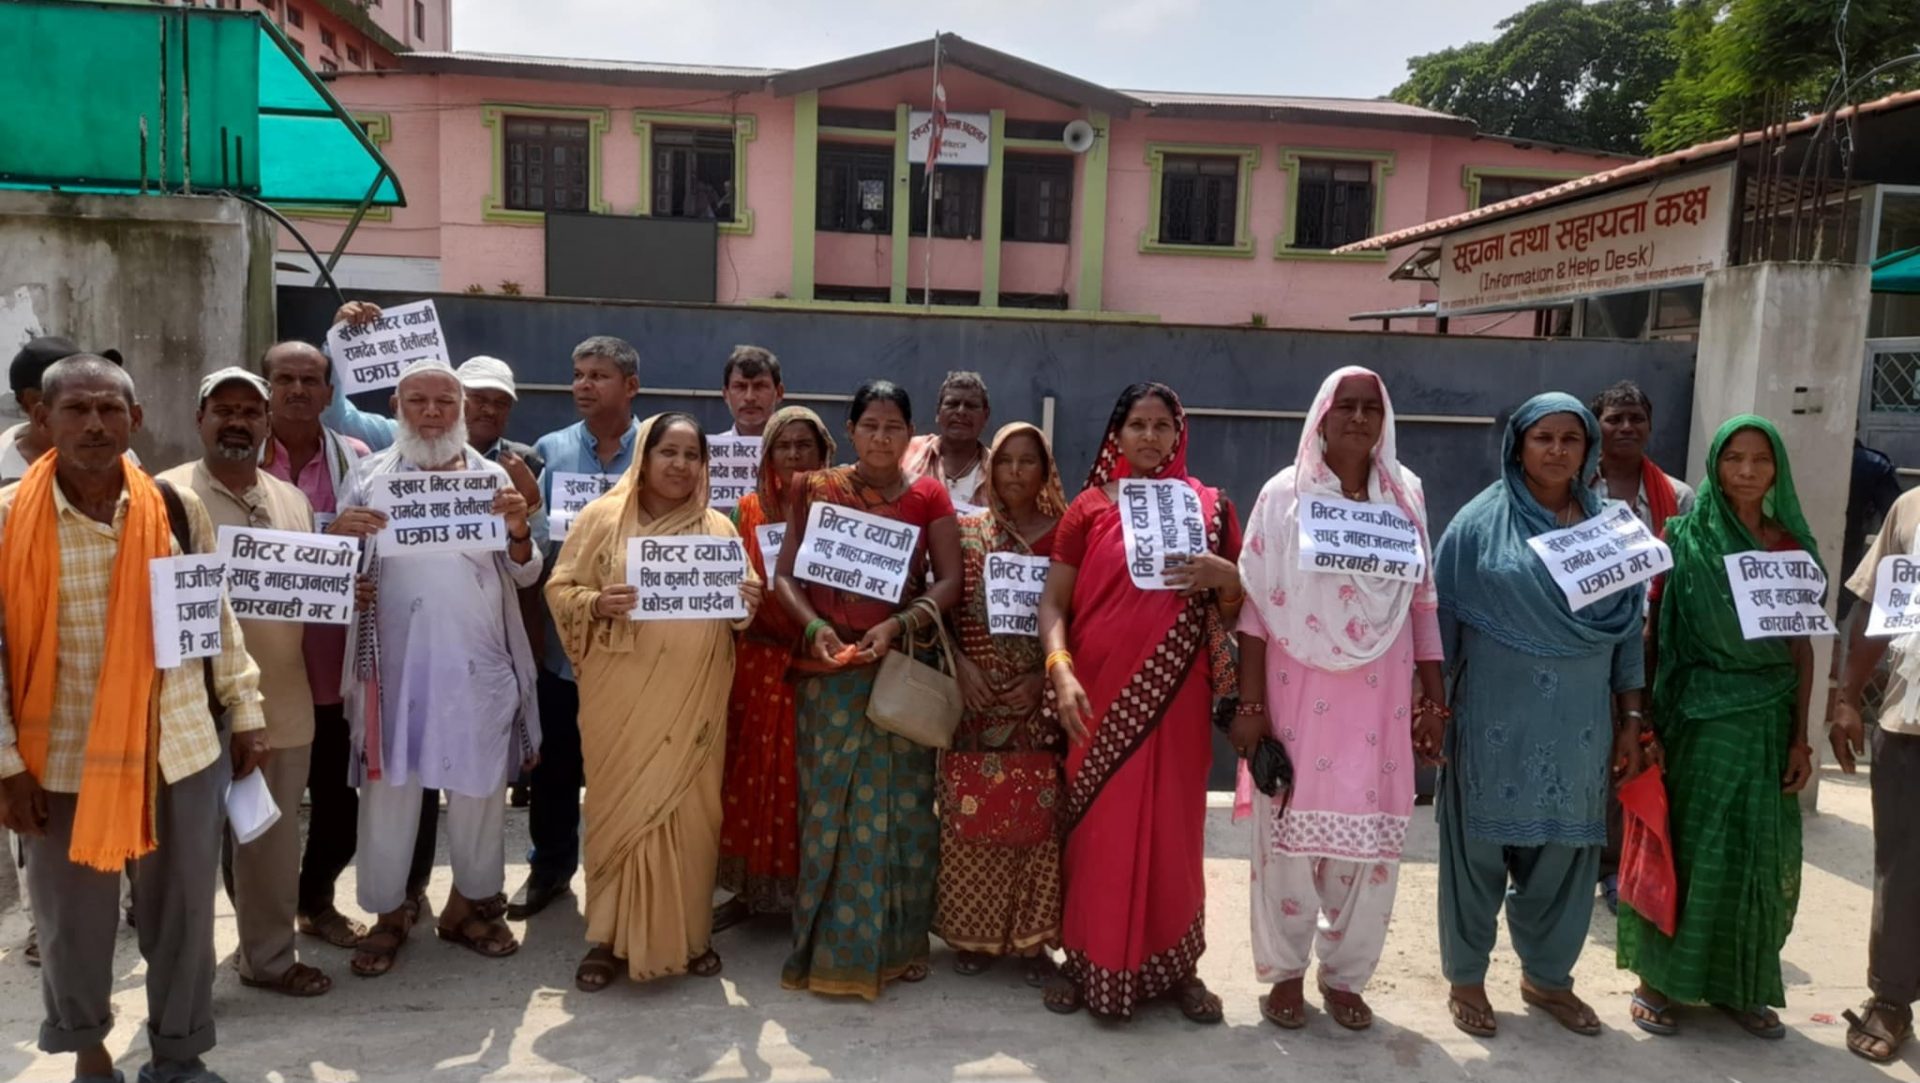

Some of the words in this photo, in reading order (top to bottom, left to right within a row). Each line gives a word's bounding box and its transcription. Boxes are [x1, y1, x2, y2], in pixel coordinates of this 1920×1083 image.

[1453, 234, 1505, 274] सूचना
[1510, 224, 1550, 256] तथा
[1556, 201, 1648, 252] सहायता
[1655, 186, 1711, 226] कक्ष
[1480, 266, 1554, 293] (Information
[1557, 262, 1566, 279] &
[1569, 256, 1599, 276] Help
[344, 341, 376, 361] रामदेव
[378, 339, 398, 356] साह
[400, 328, 439, 351] तेलीलाई
[353, 360, 400, 384] पक्राउ
[733, 441, 757, 458] मिटर
[430, 475, 460, 492] मिटर
[732, 466, 749, 480] साह
[390, 500, 426, 520] रामदेव
[429, 502, 450, 518] साह
[818, 506, 861, 538] मिटर
[1311, 501, 1348, 521] मिटर
[395, 524, 450, 546] पक्राउ
[455, 522, 482, 540] गर
[1313, 529, 1340, 548] साहु
[232, 533, 289, 562] मिटर
[641, 539, 688, 562] मिटर
[814, 537, 835, 559] साहु
[1131, 534, 1154, 577] मिटर
[989, 556, 1026, 582] मिटर
[1315, 552, 1380, 573] कारबाही
[1383, 559, 1409, 576] गर
[1560, 549, 1596, 574] रामदेव
[1576, 561, 1625, 595] पक्राउ
[1626, 550, 1652, 573] गर
[1738, 555, 1783, 582] मिटर
[232, 568, 260, 592] साहु
[264, 571, 351, 596] माहाजनलाई
[640, 567, 661, 588] शिव
[664, 567, 699, 591] कुमारी
[807, 561, 863, 588] कारबाही
[864, 576, 888, 596] गर
[990, 588, 1010, 608] साहु
[1749, 588, 1775, 610] साहु
[1888, 588, 1910, 608] शिव
[308, 603, 336, 620] गर
